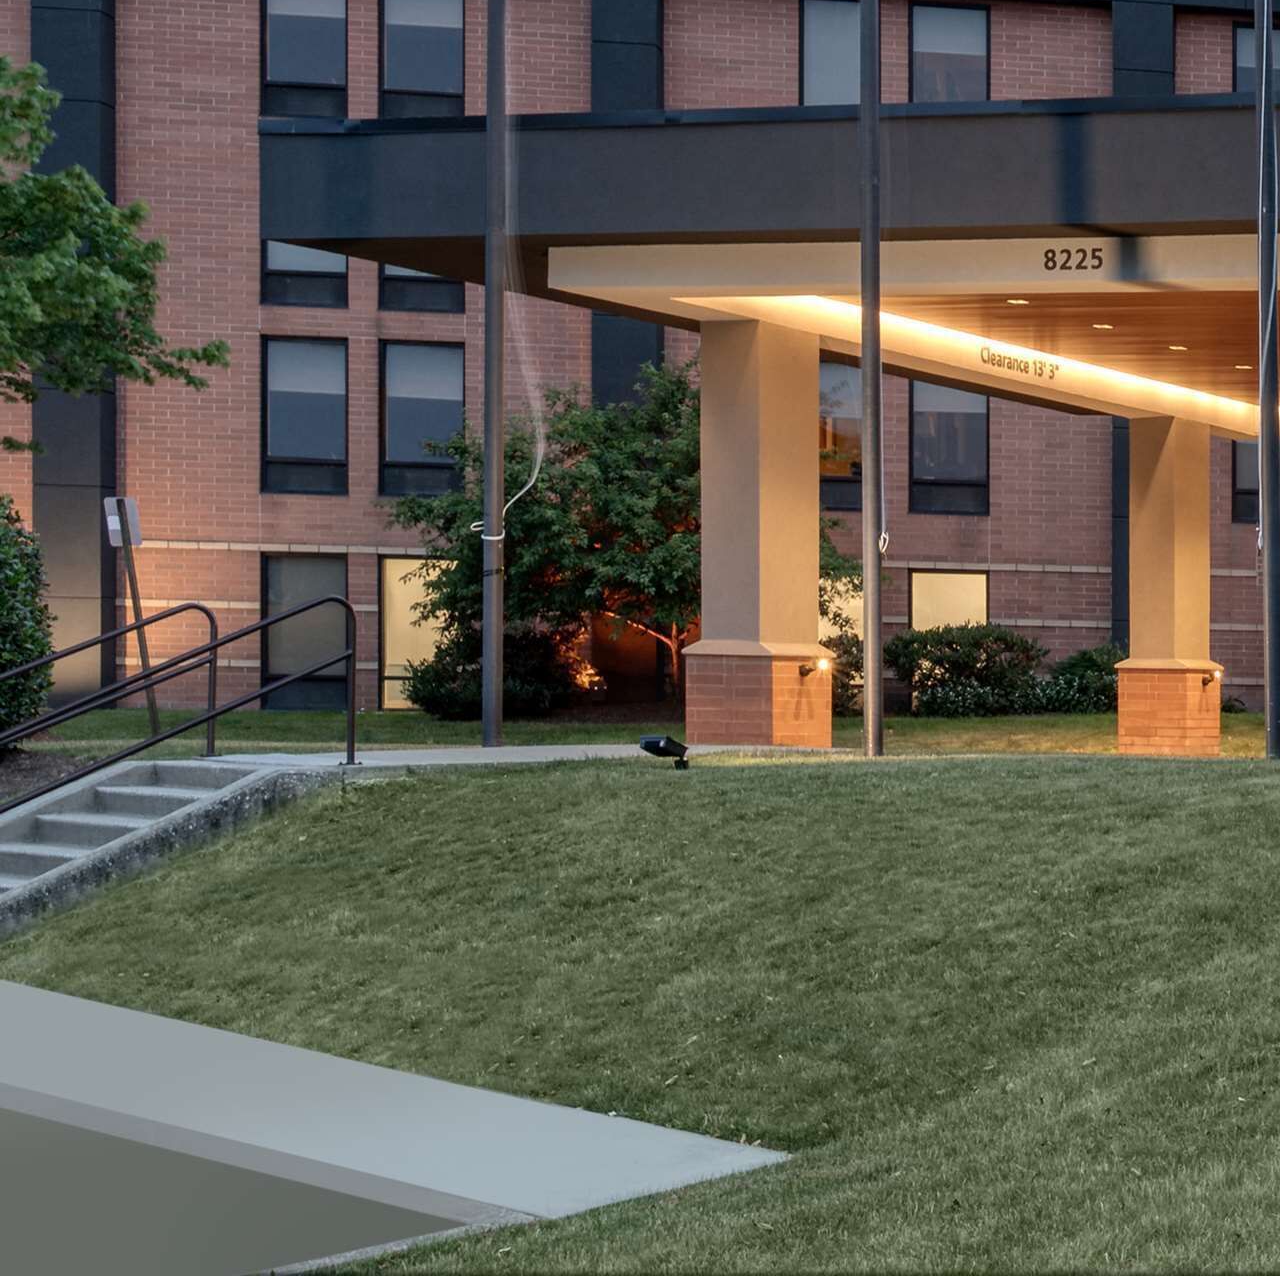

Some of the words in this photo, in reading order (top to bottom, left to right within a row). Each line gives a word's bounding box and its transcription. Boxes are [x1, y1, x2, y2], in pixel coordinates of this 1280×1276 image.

[1043, 247, 1104, 271] 8225
[981, 347, 1030, 374] Clearance
[1033, 359, 1046, 377] 13'
